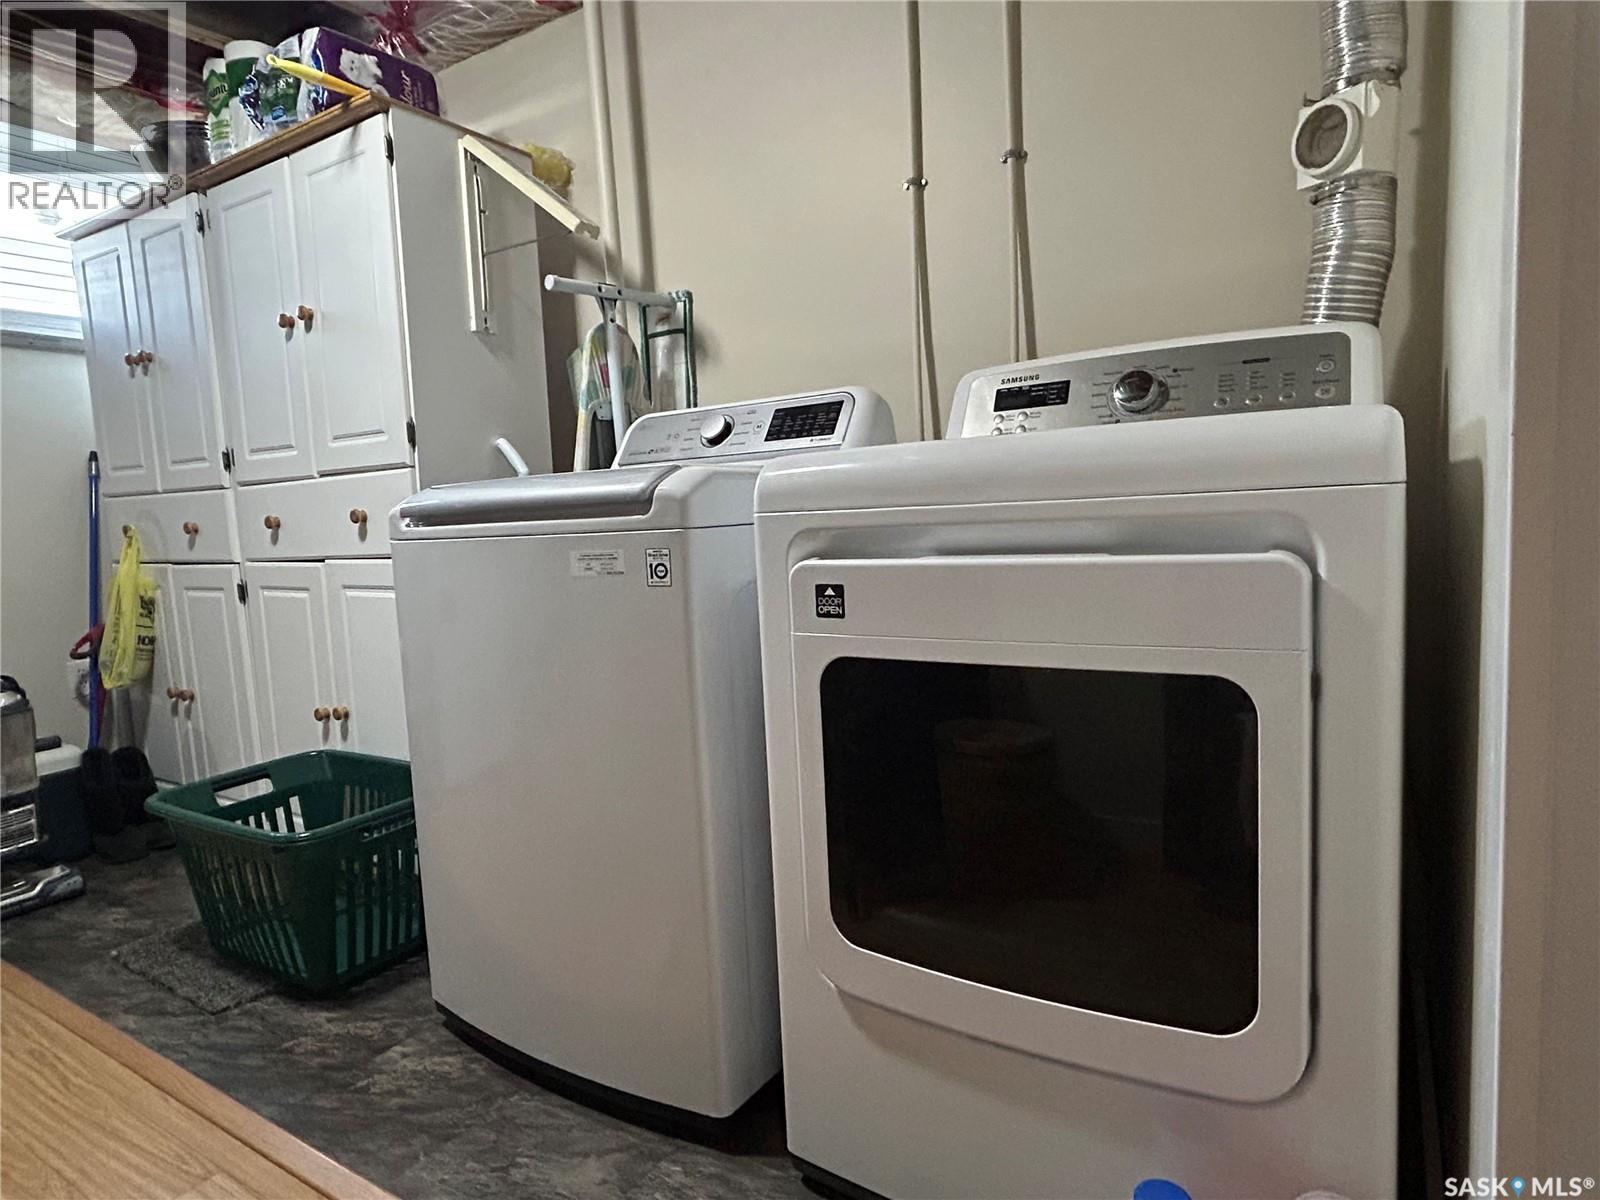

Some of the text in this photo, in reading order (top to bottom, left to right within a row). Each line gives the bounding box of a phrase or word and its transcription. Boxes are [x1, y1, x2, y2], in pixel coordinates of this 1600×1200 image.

[1000, 373, 1040, 385] SAMSUNG
[649, 562, 668, 580] 10
[818, 597, 841, 606] DOOR
[818, 605, 842, 615] OPEN
